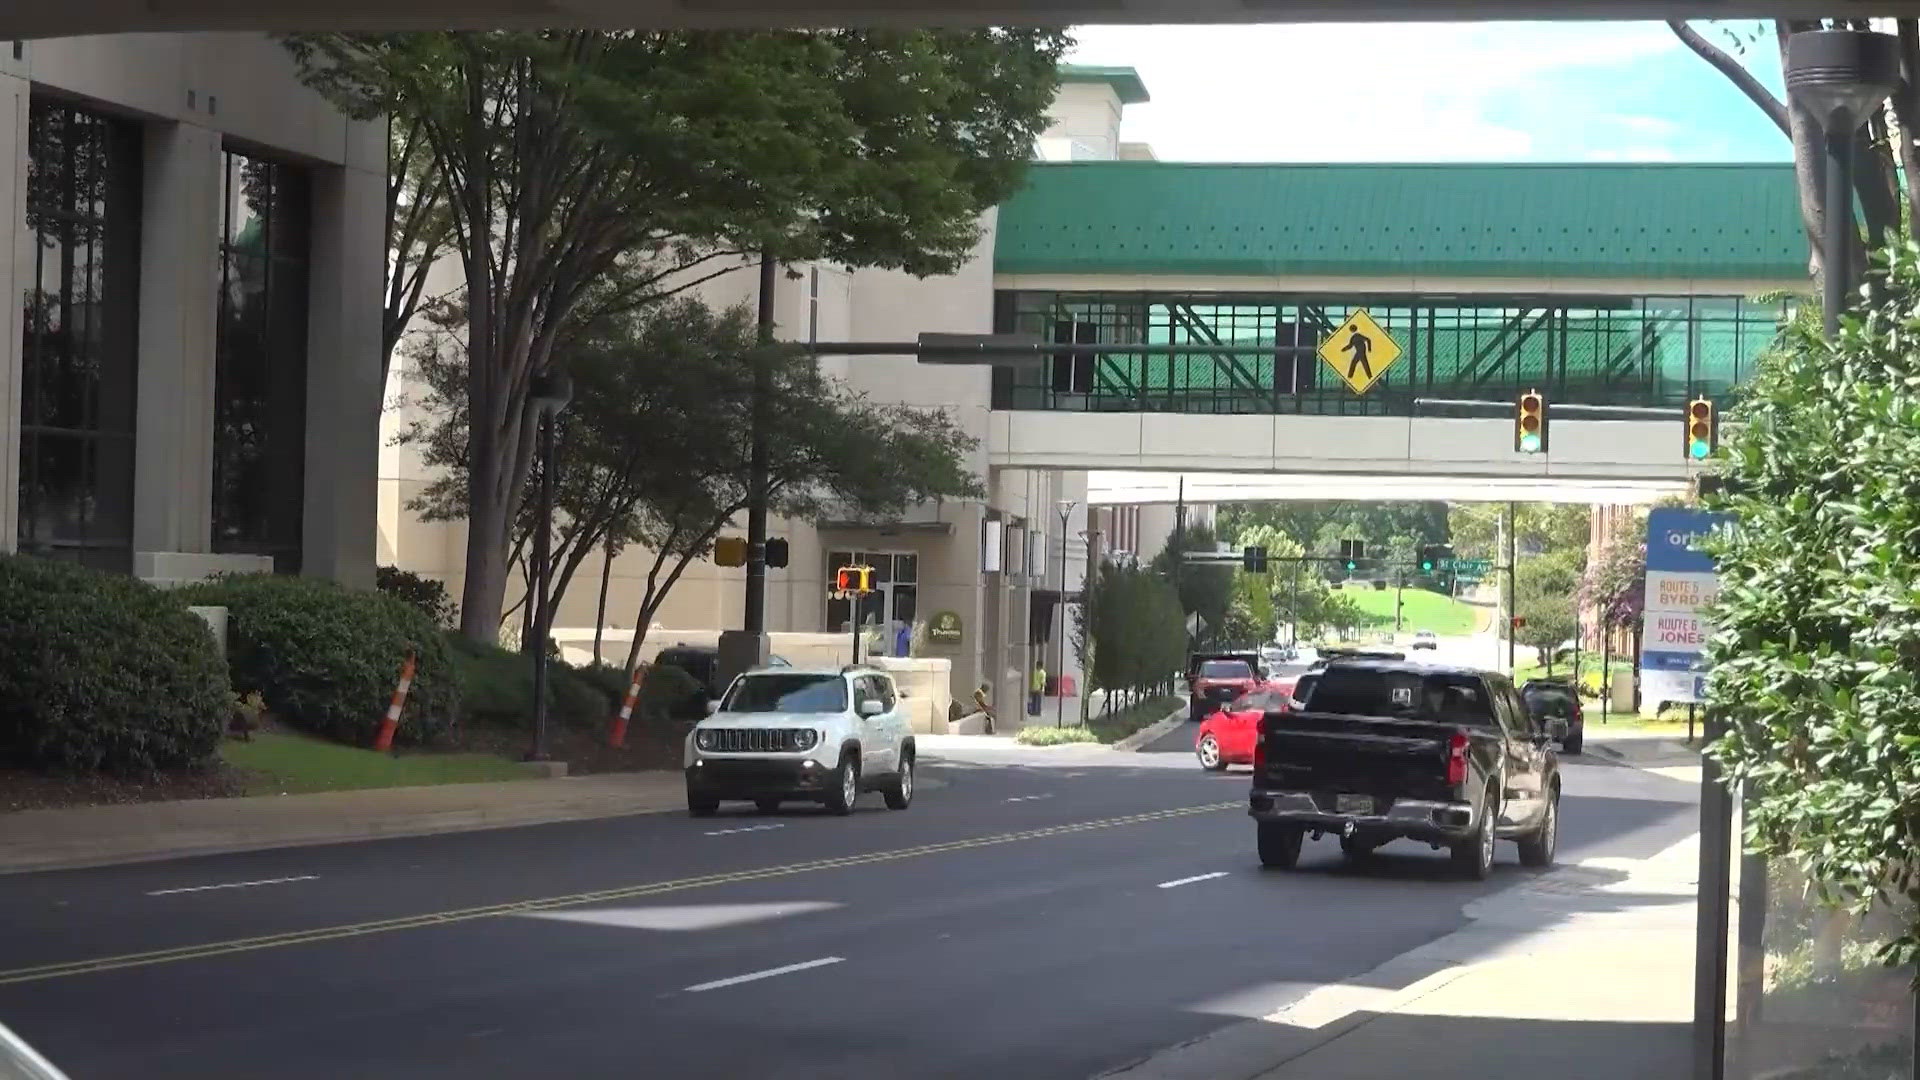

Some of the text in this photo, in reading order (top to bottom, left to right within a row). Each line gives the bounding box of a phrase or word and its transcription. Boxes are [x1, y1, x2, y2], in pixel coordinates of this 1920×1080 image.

[1452, 561, 1473, 569] Clair
[1476, 563, 1492, 572] Ave
[1659, 581, 1690, 593] ROUTE
[1659, 593, 1699, 605] BYRD
[1657, 618, 1688, 631] ROUTE
[1657, 631, 1705, 644] JONES
